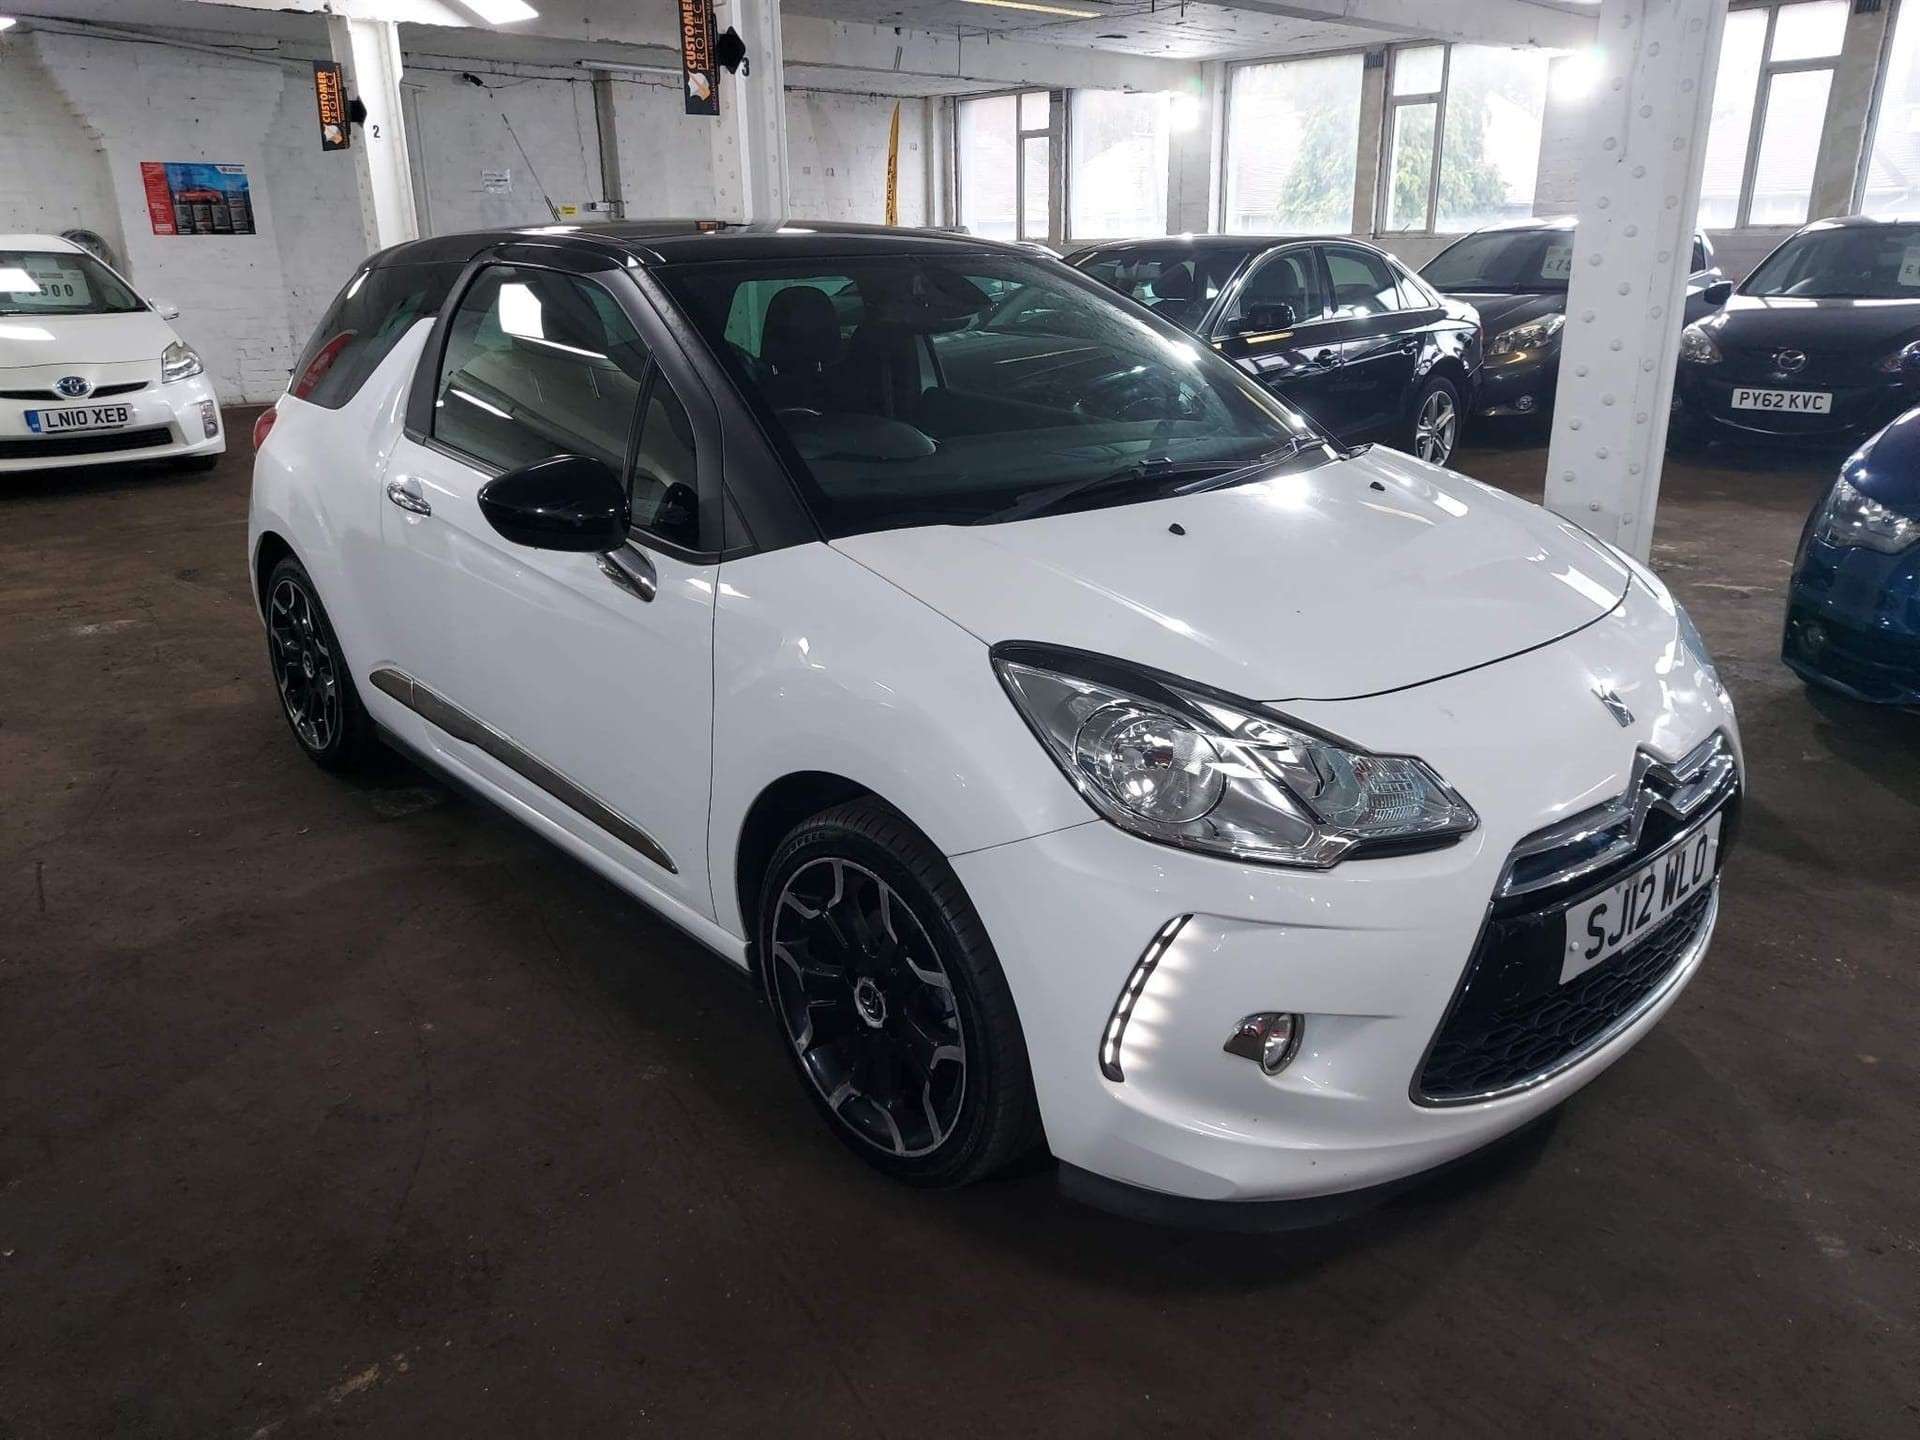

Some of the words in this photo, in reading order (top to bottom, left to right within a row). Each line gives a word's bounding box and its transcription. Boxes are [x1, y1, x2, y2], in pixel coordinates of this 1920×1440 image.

[741, 57, 750, 77] 3
[317, 71, 331, 123] CUSTOMER
[325, 71, 338, 124] PROTECT
[372, 124, 381, 139] 2
[1739, 391, 1785, 408] PY62
[1788, 394, 1824, 410] KVC
[45, 410, 88, 428] LN10
[92, 407, 128, 424] XEB
[1584, 873, 1656, 960] SJ12
